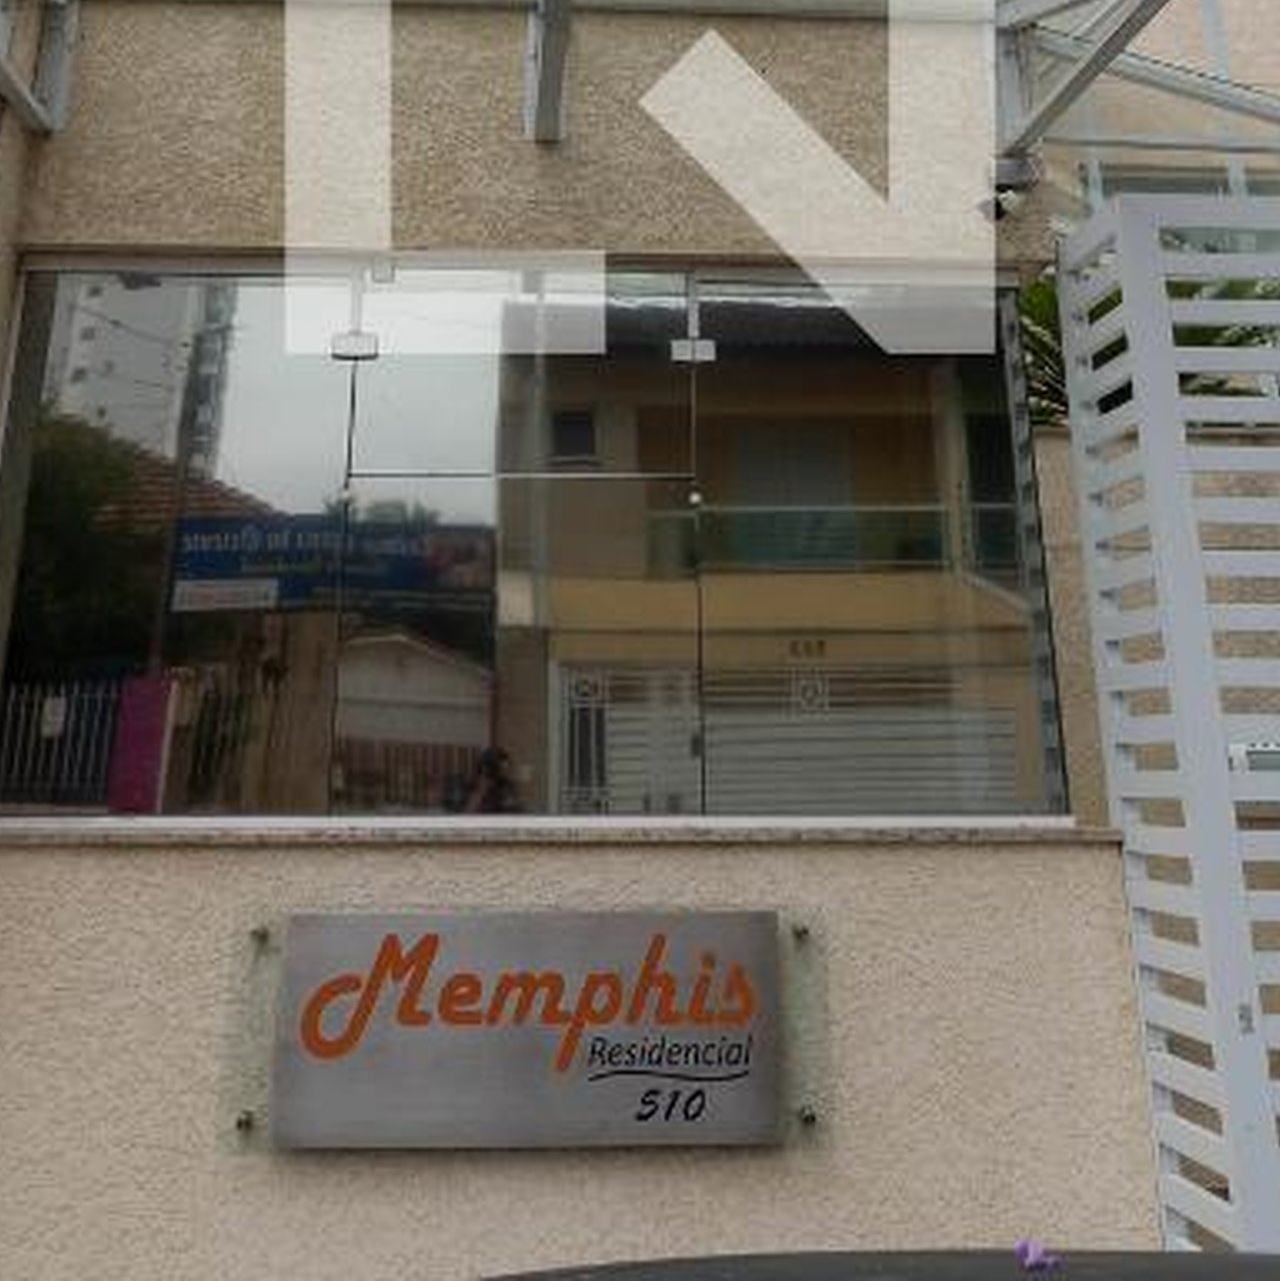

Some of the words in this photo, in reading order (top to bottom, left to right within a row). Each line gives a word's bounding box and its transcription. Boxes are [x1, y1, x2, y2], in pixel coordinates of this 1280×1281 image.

[298, 932, 758, 1072] Memphis
[588, 1034, 752, 1066] Residencial
[635, 1088, 706, 1121] 510
